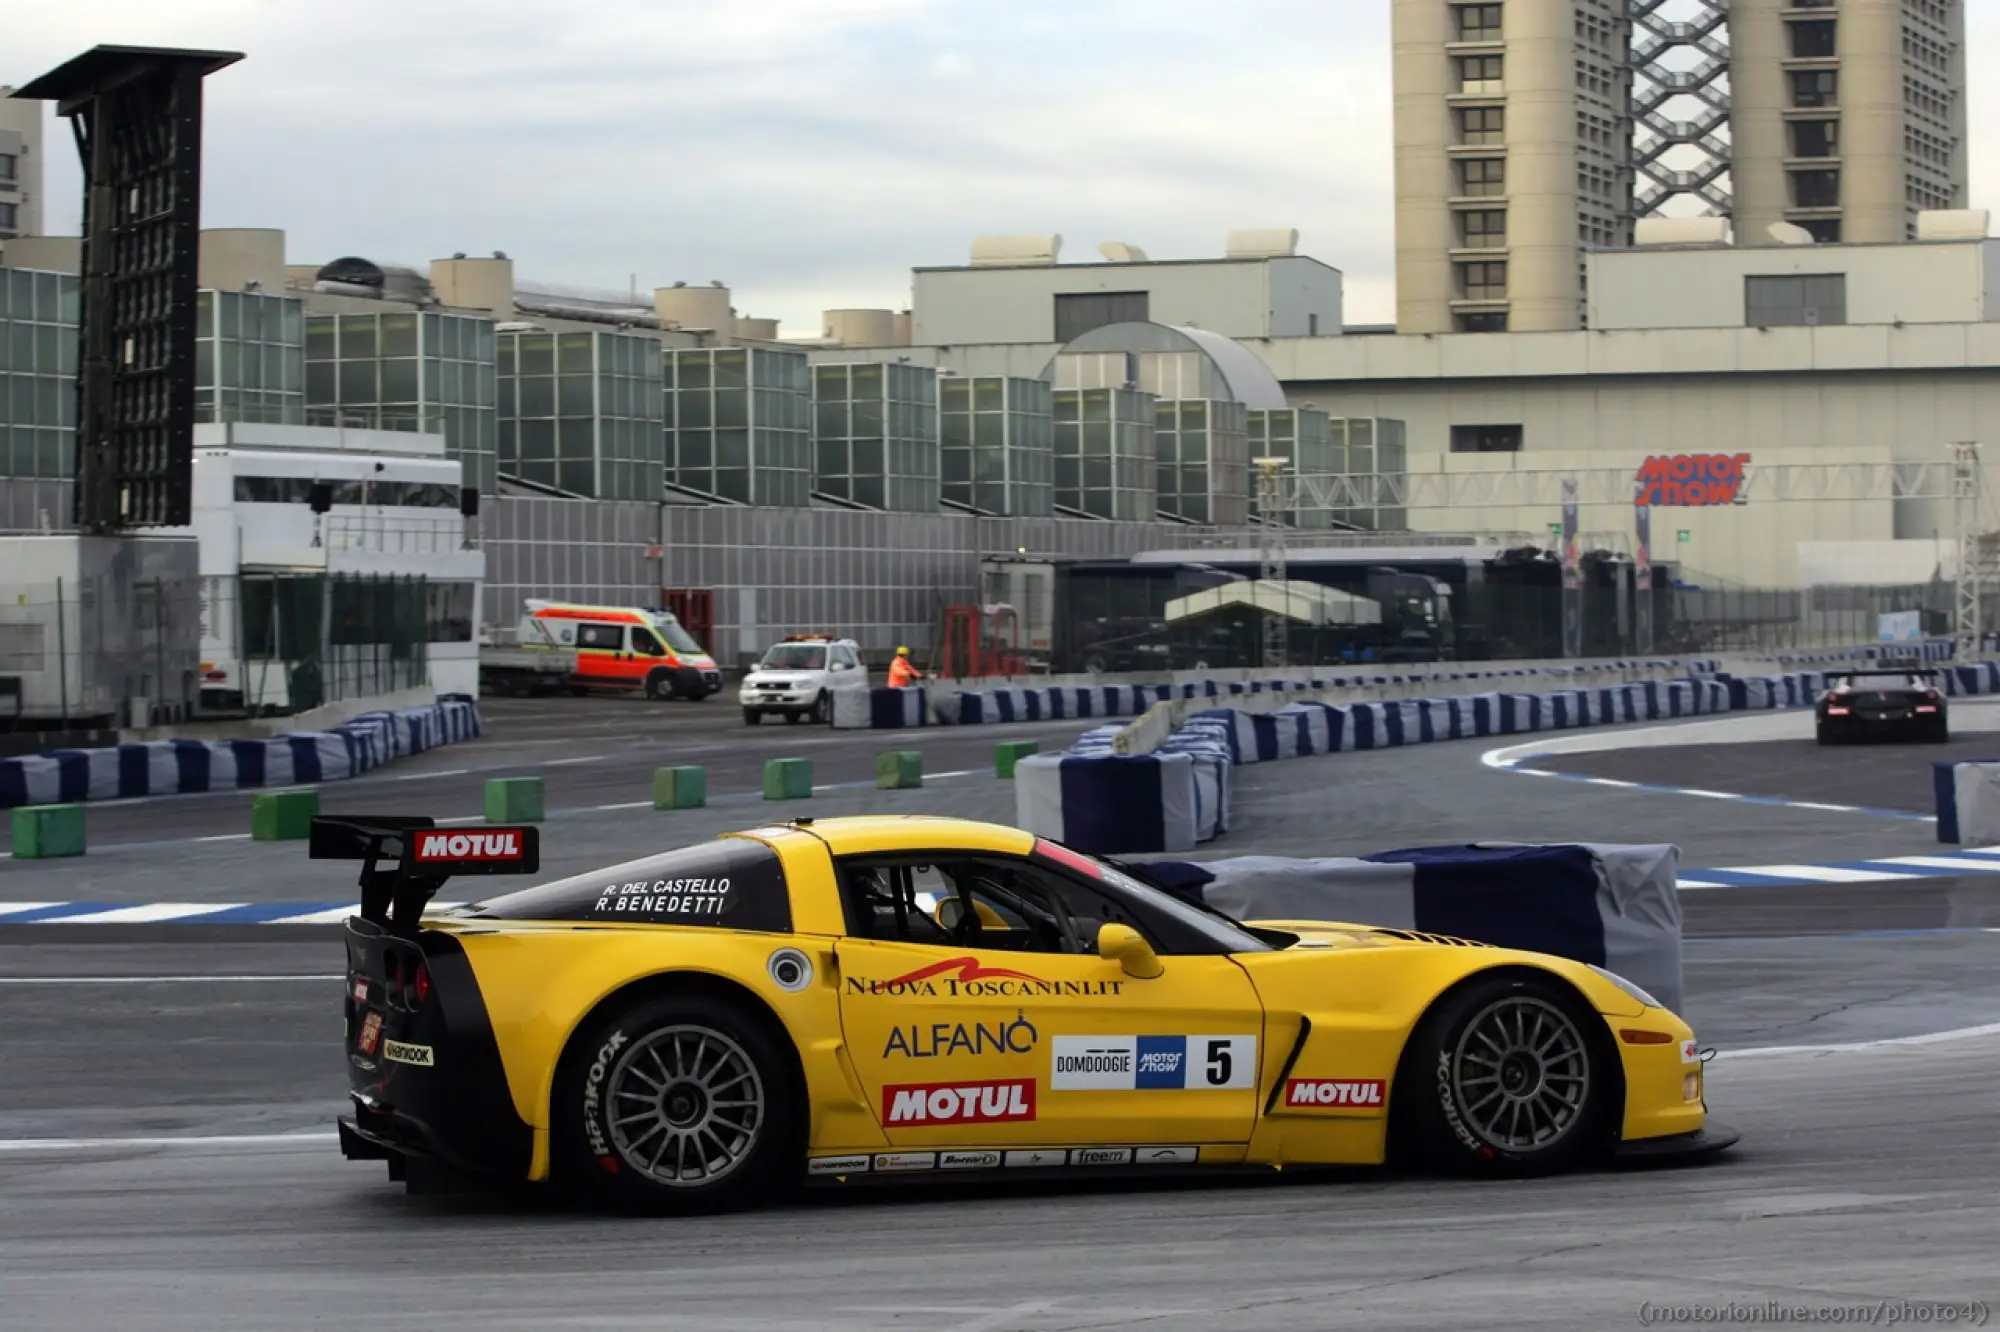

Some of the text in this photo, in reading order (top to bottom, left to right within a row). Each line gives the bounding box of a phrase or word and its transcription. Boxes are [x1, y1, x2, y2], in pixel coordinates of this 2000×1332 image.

[422, 834, 518, 857] MOTUL
[603, 878, 731, 896] R. DEL CASTELLO
[847, 976, 1124, 997] NUOVA TOSCANINI.IT
[883, 1010, 1037, 1058] ALFANO
[1206, 1040, 1232, 1086] 5
[888, 1084, 1029, 1122] MOTUL
[1291, 1082, 1381, 1104] MOTUL
